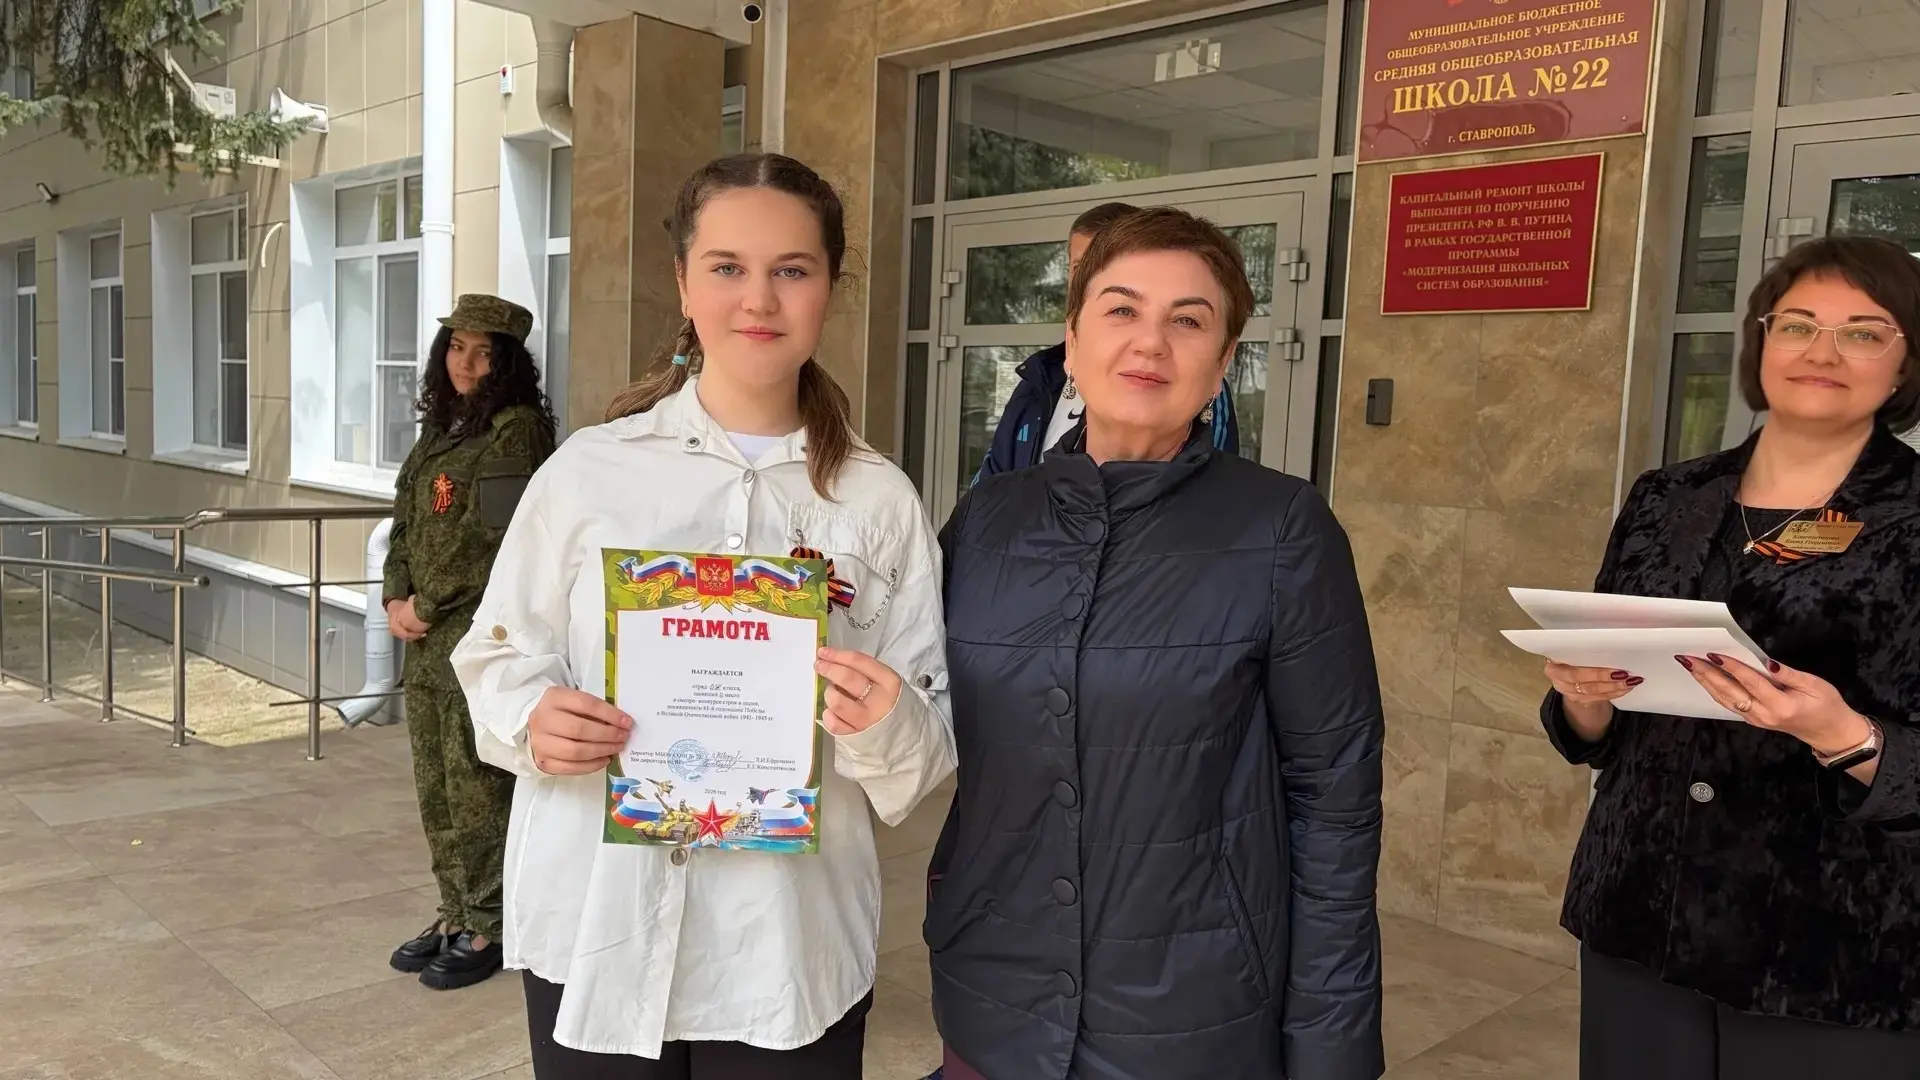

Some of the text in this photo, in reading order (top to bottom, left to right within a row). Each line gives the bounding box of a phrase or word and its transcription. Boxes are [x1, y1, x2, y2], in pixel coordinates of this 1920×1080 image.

[1407, 0, 1602, 42] МУНИЦИПАЛЬНОЕ БЮДЖЕТНОЕ
[1387, 12, 1625, 60] ОБЩЕОБРАЗОВАТЕЛЬНОЕ УЧРЕЖДЕНИЕ
[1374, 30, 1639, 82] СРЕДНЯЯ ОБЩЕОБРАЗОВАТЕЛЬНАЯ
[1392, 57, 1610, 114] ШКОЛА №22
[1448, 123, 1536, 144] г. СТАВРОПОЛЬ
[1400, 180, 1585, 205] КАПИТАЛЬНЫЙ РЕМОНТ ШКОЛЫ
[1410, 197, 1570, 219] ВЫПОЛНЕН ПО ПОРУЧЕНИЮ
[1406, 213, 1573, 233] ПРЕЗИДЕНТА РФ В. В. ПУТИНА
[1404, 229, 1572, 248] В РАМКАХ ГОСУДАРСТВЕННОЙ
[1448, 247, 1520, 260] ПРОГРАММЫ
[1499, 260, 1570, 273] ШКОЛЬНЫХ
[1416, 280, 1460, 291] СИСТЕМ
[662, 618, 770, 641] ГРАМОТА
[691, 668, 743, 677] НАГРАЖДАЕТСЯ
